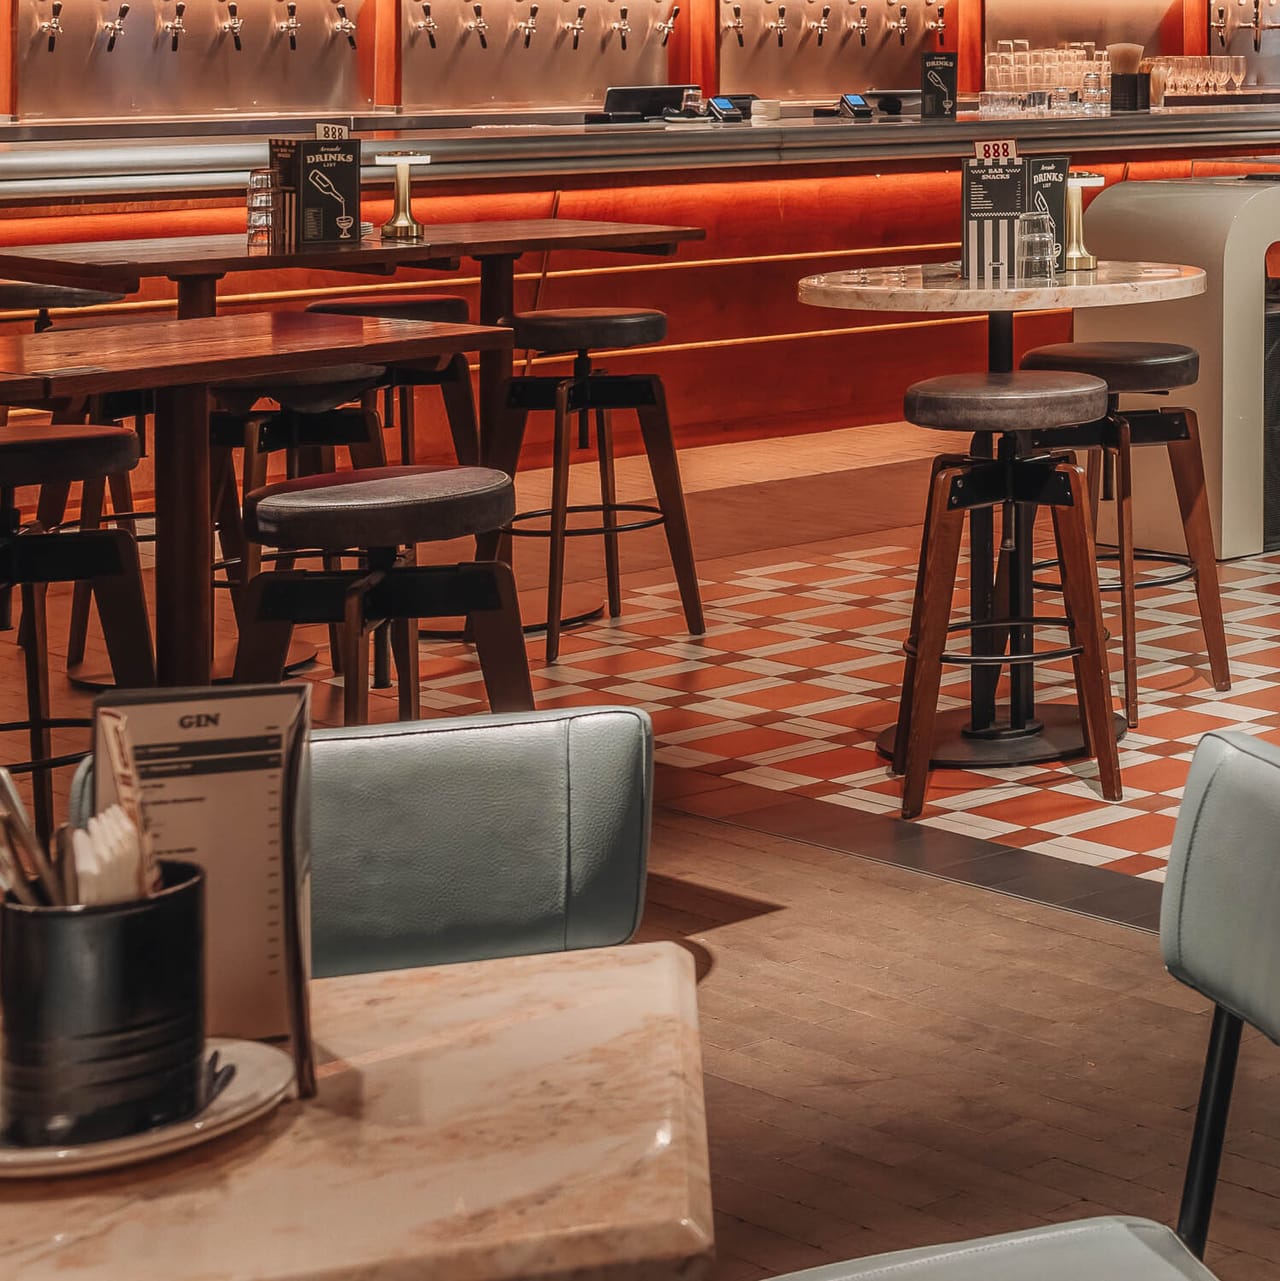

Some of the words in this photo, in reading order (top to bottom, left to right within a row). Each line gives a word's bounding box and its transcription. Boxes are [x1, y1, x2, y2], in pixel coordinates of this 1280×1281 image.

[323, 126, 344, 140] 888
[983, 142, 1010, 159] 888
[306, 153, 354, 164] DRINKS
[1033, 172, 1064, 185] DRINKS
[178, 713, 221, 729] GIN
